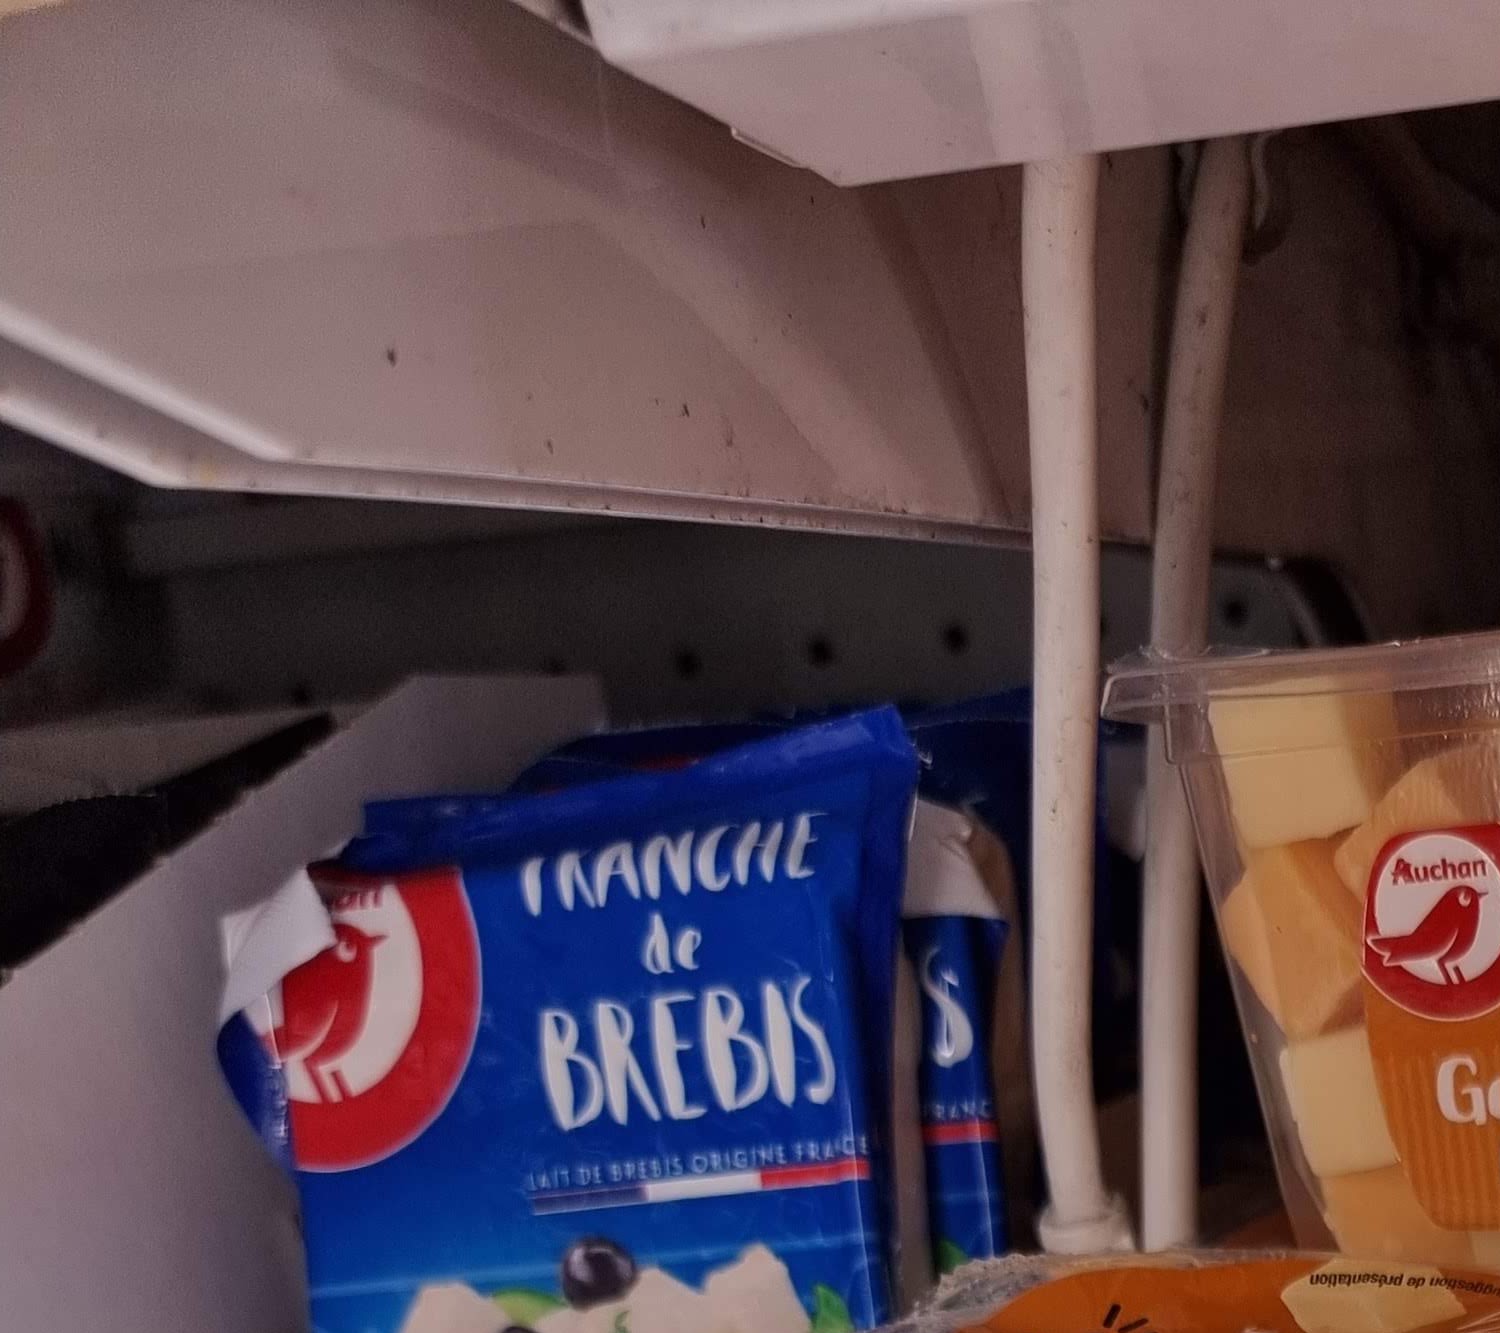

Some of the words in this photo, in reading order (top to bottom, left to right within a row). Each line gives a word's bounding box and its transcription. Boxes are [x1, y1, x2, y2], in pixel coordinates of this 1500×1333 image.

[1391, 857, 1488, 887] Auchan
[643, 913, 701, 975] de
[539, 975, 834, 1134] BREBIS
[690, 1144, 787, 1174] ORIGINE
[1309, 1272, 1405, 1289] présentation
[1406, 1274, 1426, 1289] de
